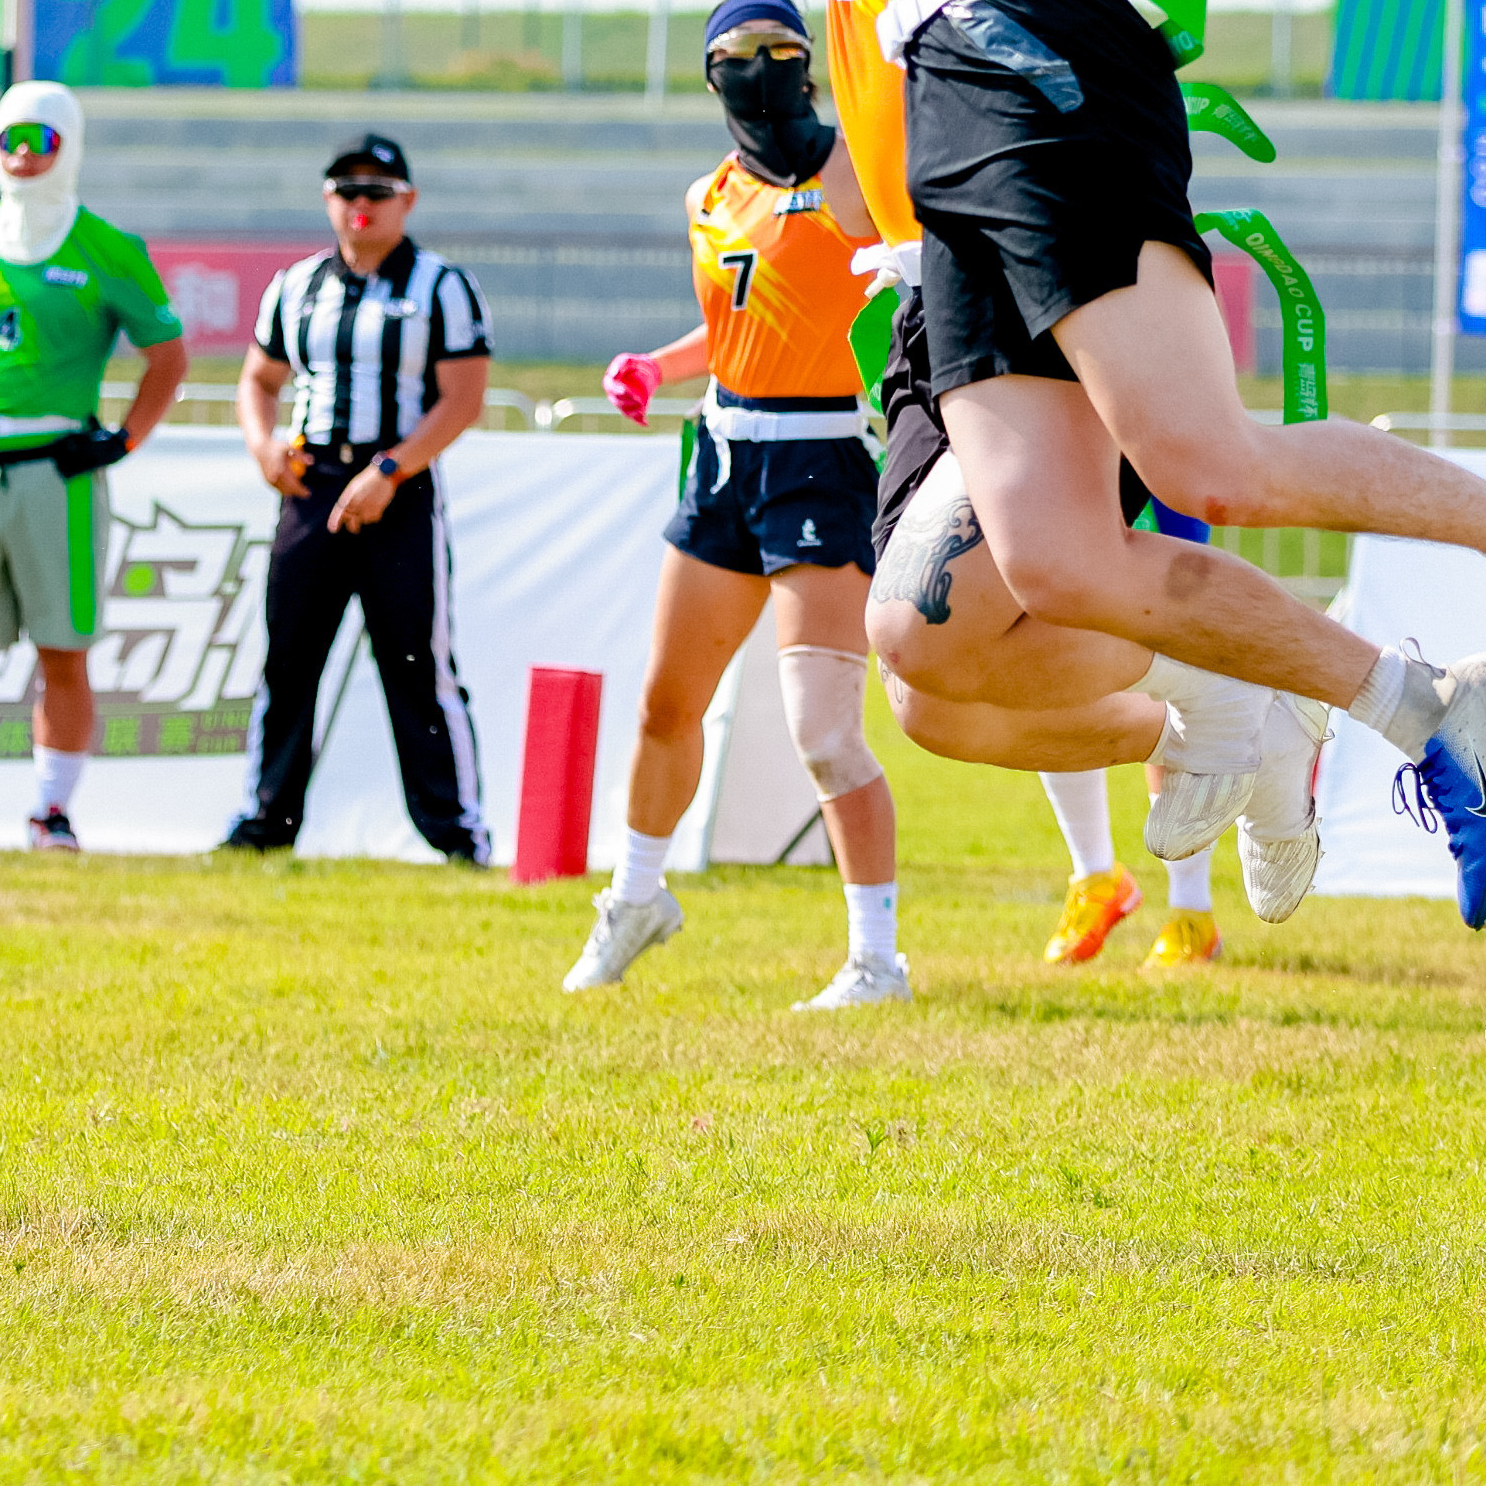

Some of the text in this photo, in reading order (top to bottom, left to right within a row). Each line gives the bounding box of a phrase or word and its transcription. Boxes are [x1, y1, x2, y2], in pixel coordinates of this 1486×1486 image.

[718, 249, 759, 311] 7
[1245, 232, 1305, 299] QINGDAO
[1294, 303, 1315, 352] CUP
